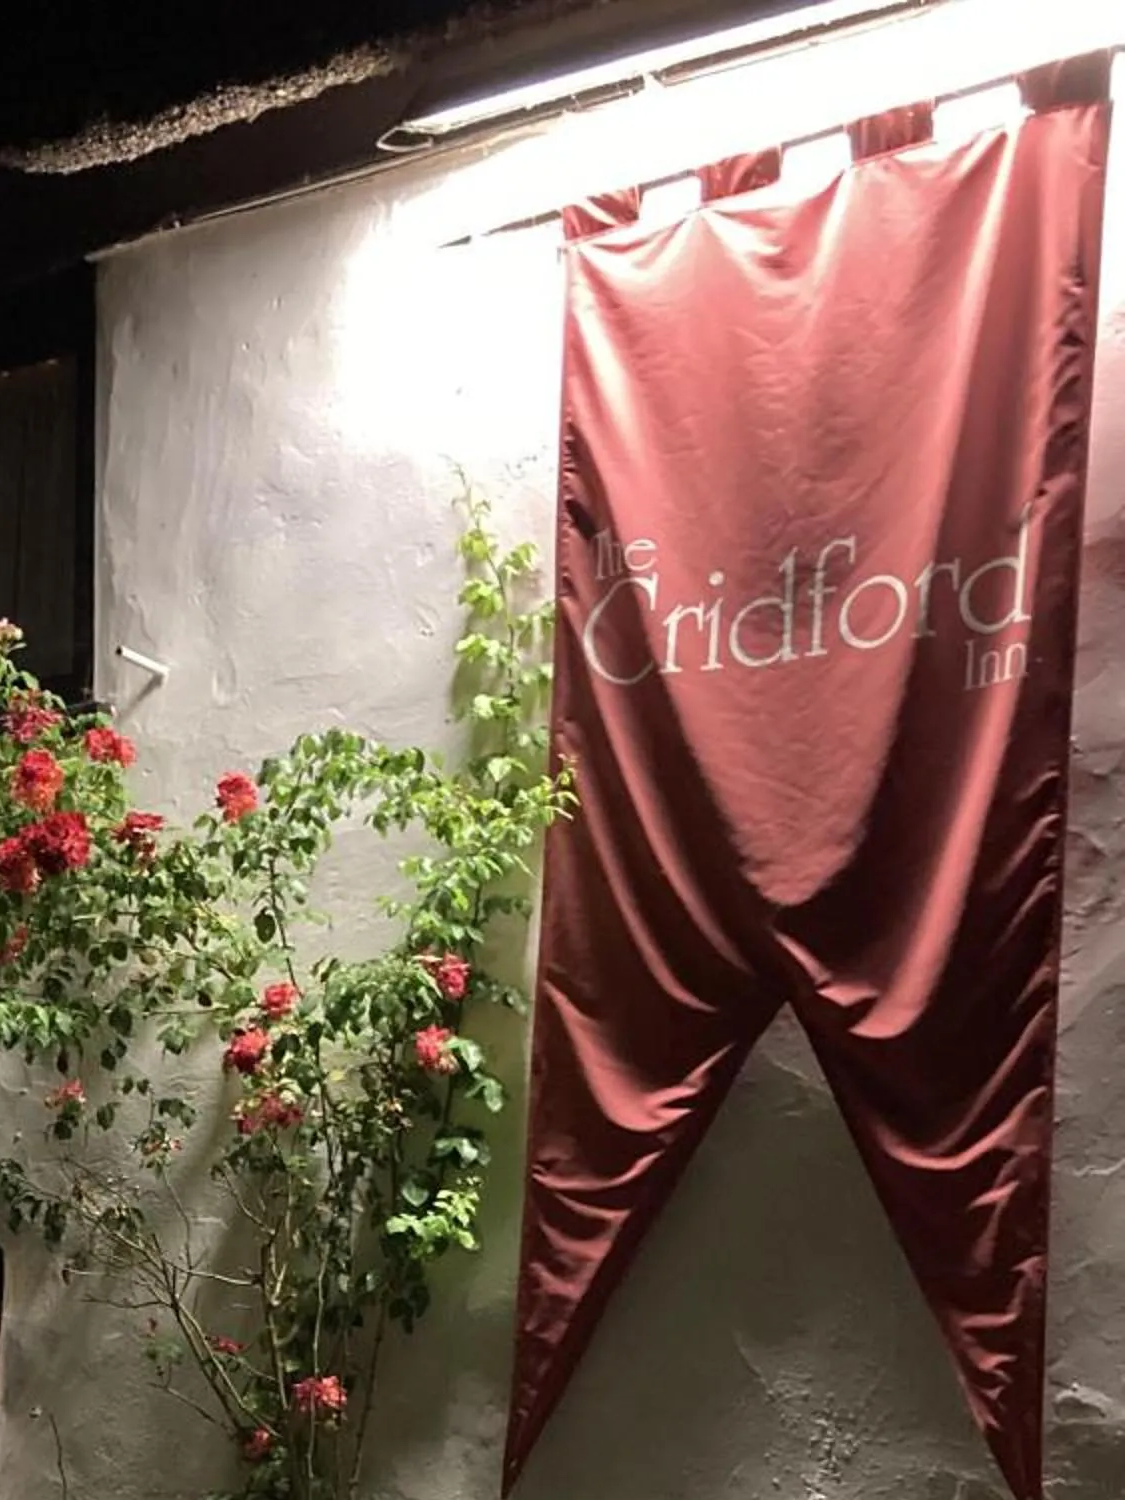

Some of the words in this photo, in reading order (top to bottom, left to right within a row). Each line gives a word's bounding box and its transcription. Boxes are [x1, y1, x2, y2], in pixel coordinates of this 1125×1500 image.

[592, 527, 658, 580] The
[582, 500, 1032, 685] Cridford
[963, 640, 1030, 690] Inn
